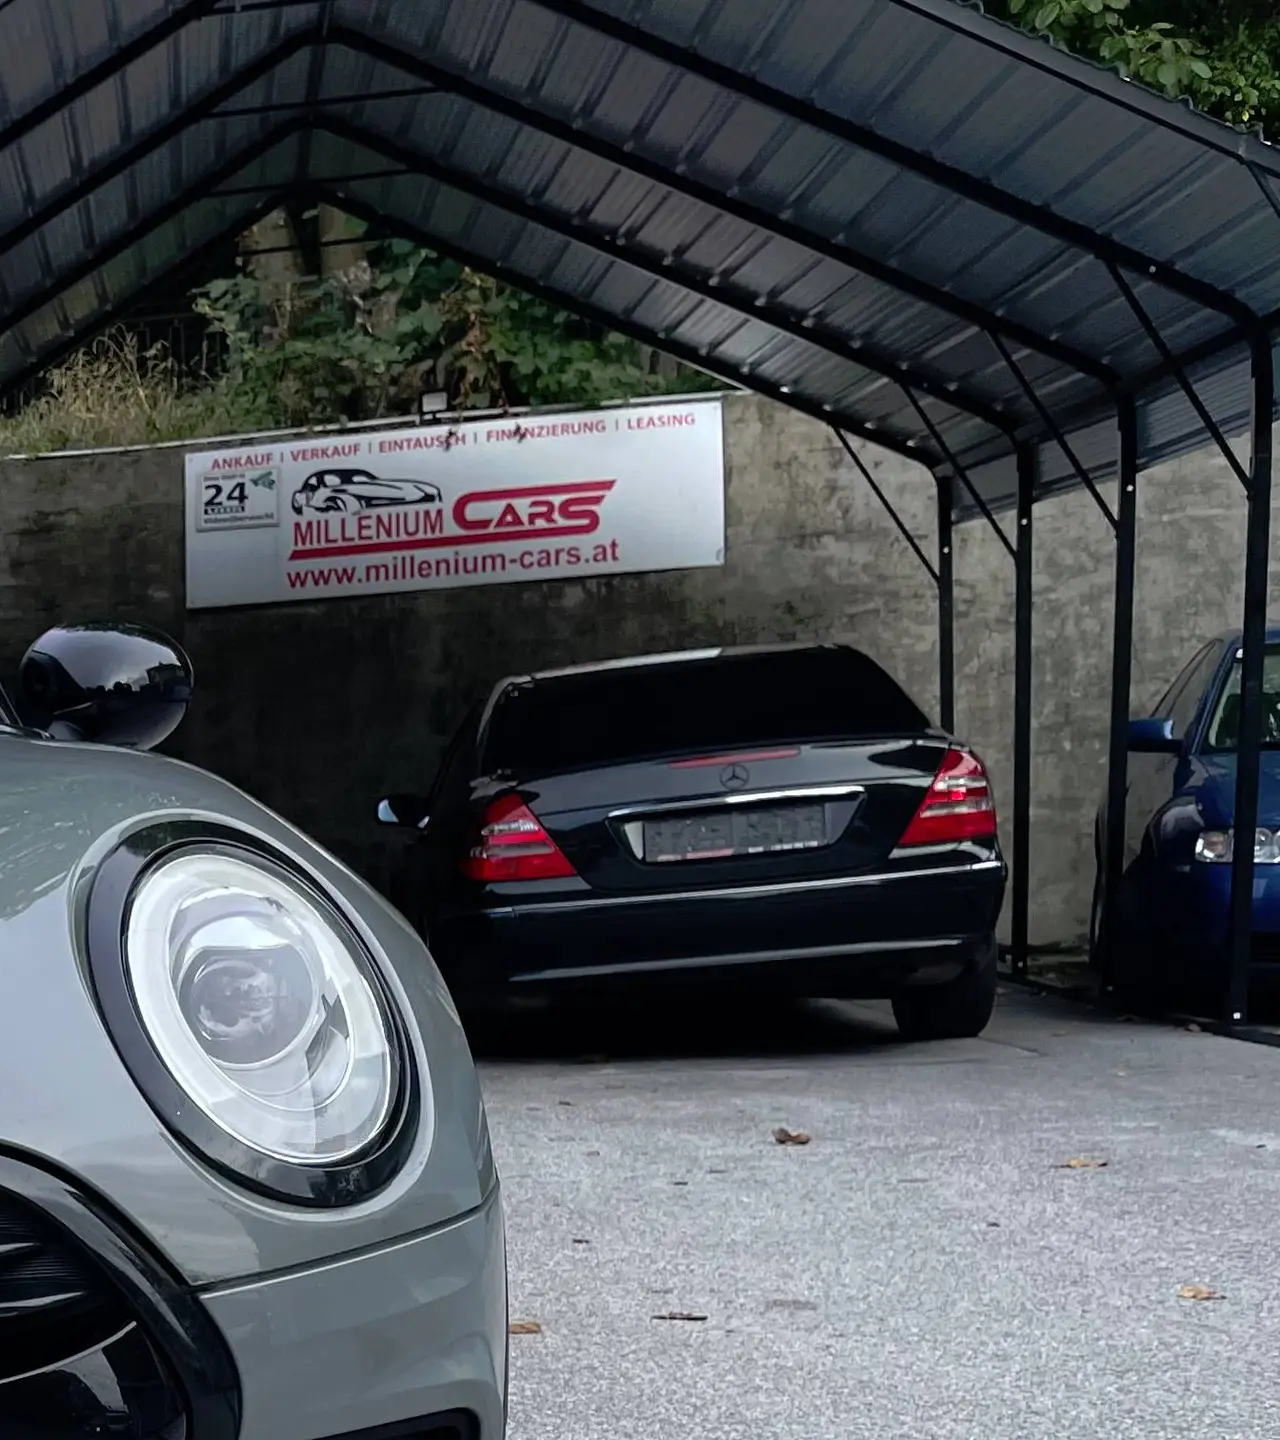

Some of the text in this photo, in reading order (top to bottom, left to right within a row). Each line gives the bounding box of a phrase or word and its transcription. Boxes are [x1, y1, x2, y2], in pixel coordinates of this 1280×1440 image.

[211, 451, 274, 470] ANKAUF
[290, 443, 361, 464] VERKAUF
[627, 412, 695, 431] LEASING
[203, 482, 248, 507] 24
[293, 479, 618, 547] MILLENIUM CARS
[287, 539, 620, 589] www.millenium-cars.at
